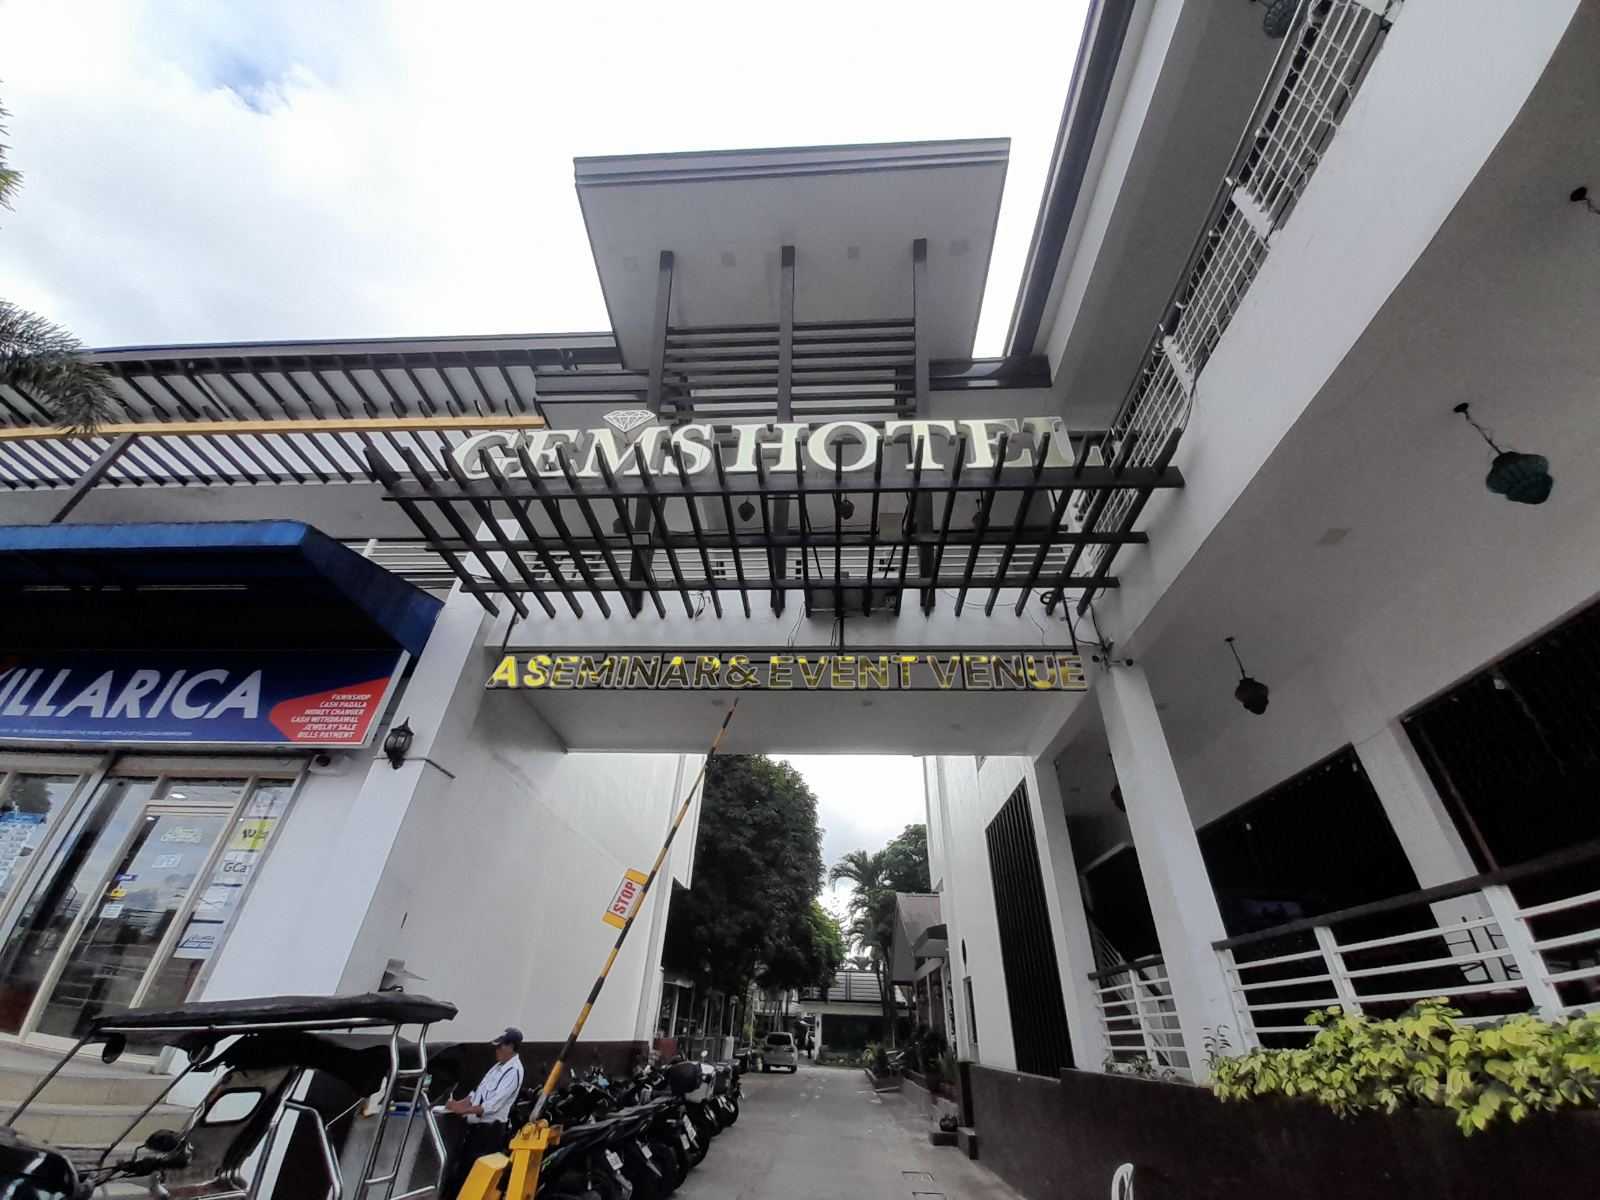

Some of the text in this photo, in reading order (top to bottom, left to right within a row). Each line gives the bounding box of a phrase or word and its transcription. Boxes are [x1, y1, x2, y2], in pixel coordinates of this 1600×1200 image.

[485, 655, 518, 687] A
[522, 654, 722, 688] SEMINAR
[768, 655, 920, 688] EVENT
[926, 655, 1089, 689] VENUE
[0, 668, 262, 720] ILLARICA
[613, 881, 636, 914] STOP
